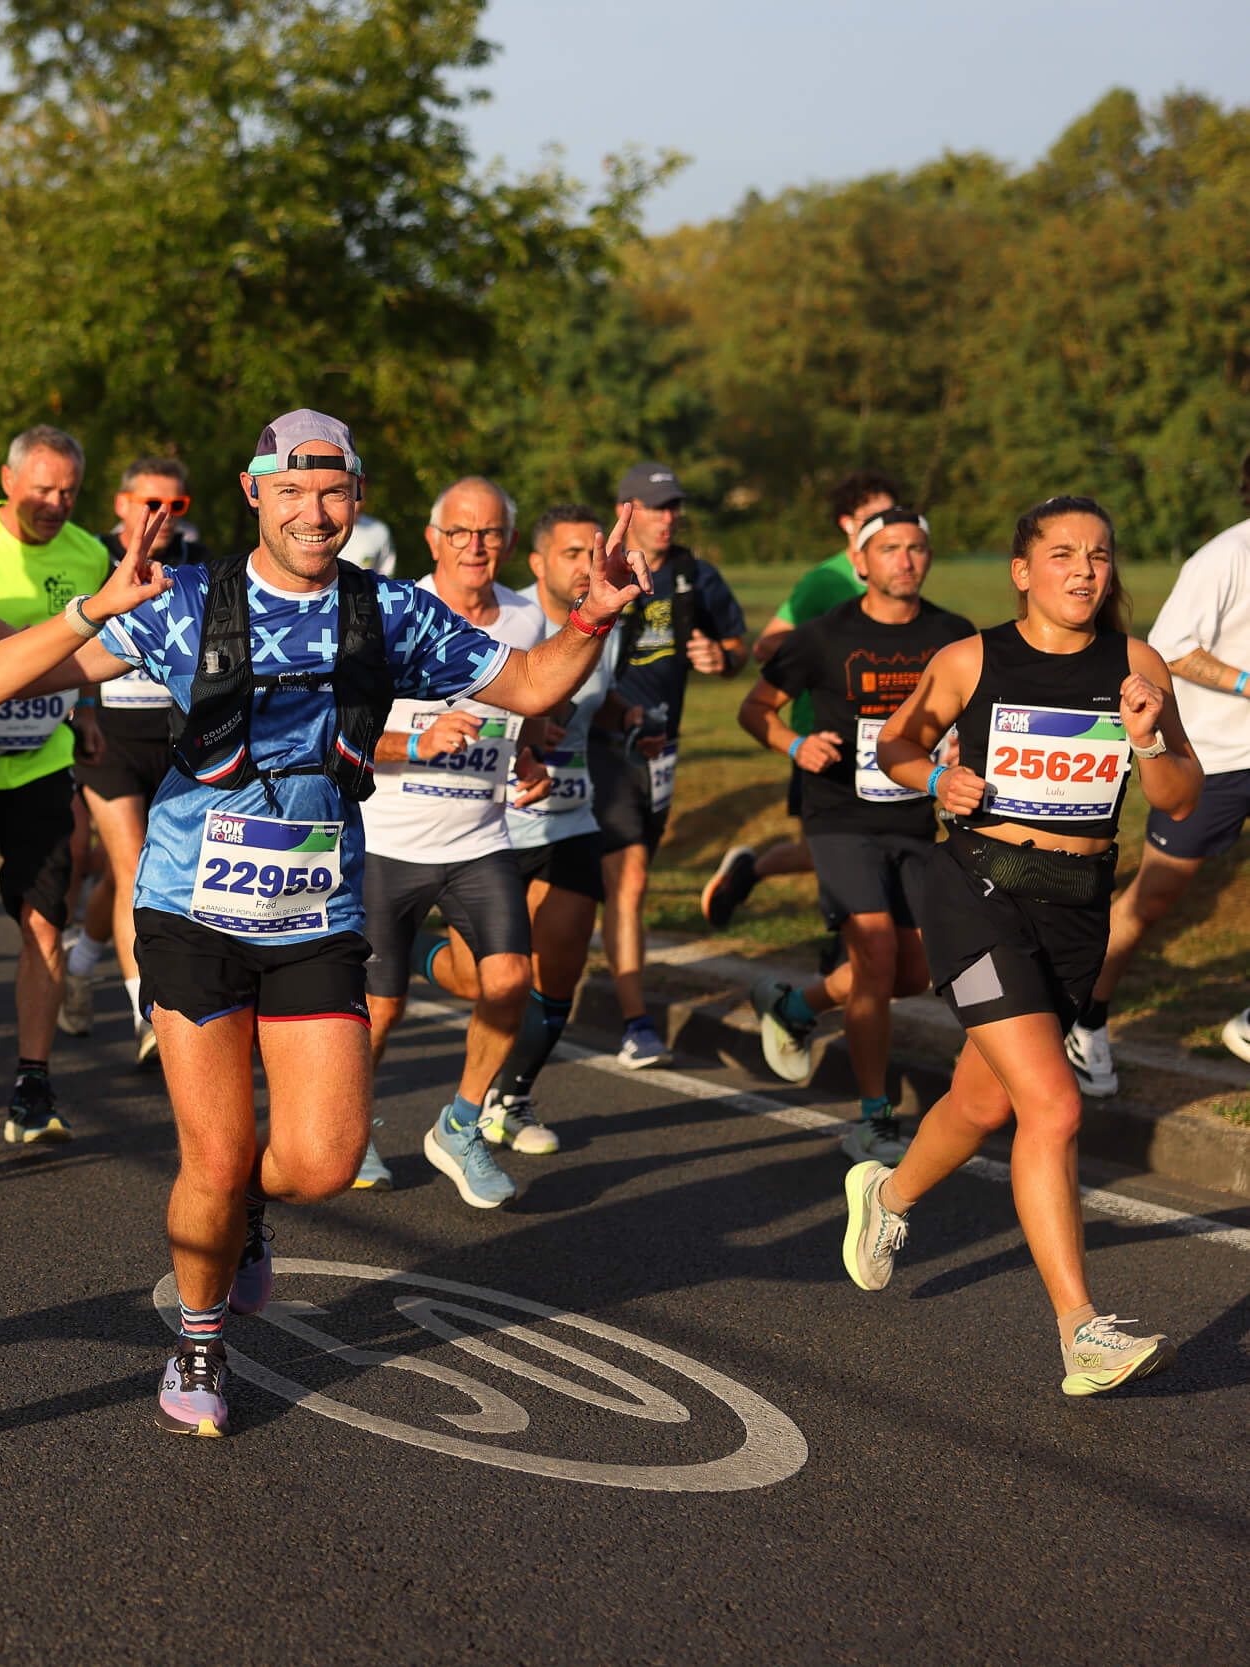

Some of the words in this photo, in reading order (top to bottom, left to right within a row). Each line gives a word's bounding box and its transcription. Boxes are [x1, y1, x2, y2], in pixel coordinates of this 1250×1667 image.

[998, 711, 1030, 725] 20K
[993, 746, 1119, 783] 25624
[212, 818, 246, 836] 20K
[211, 832, 244, 844] TOURS
[202, 858, 333, 898] 22959
[255, 900, 277, 910] Fred
